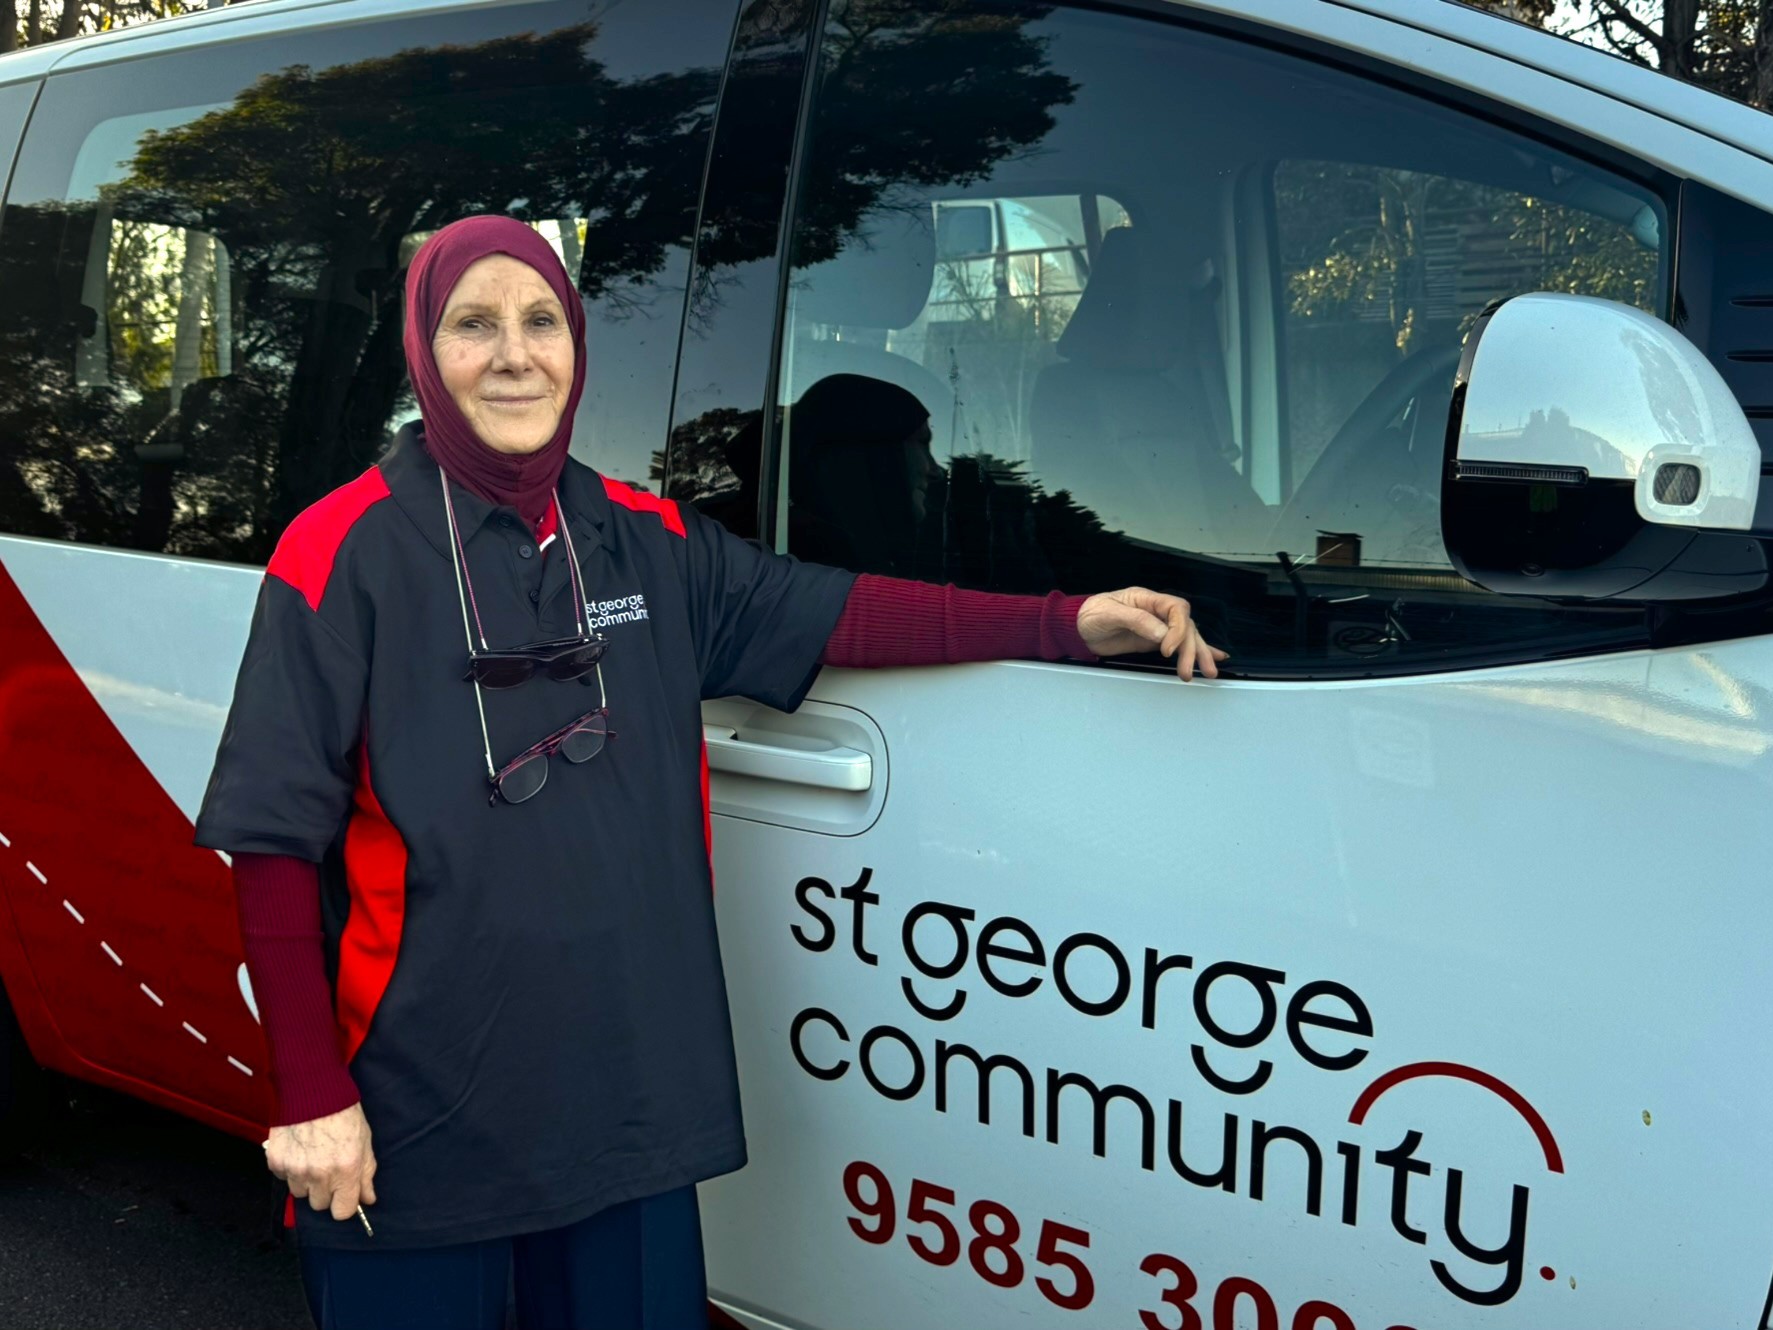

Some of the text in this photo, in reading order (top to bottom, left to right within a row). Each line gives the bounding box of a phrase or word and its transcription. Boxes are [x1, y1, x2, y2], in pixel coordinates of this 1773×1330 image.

[598, 594, 644, 616] george
[789, 867, 1375, 1096] st george
[842, 1160, 1417, 1330] 9585 30
